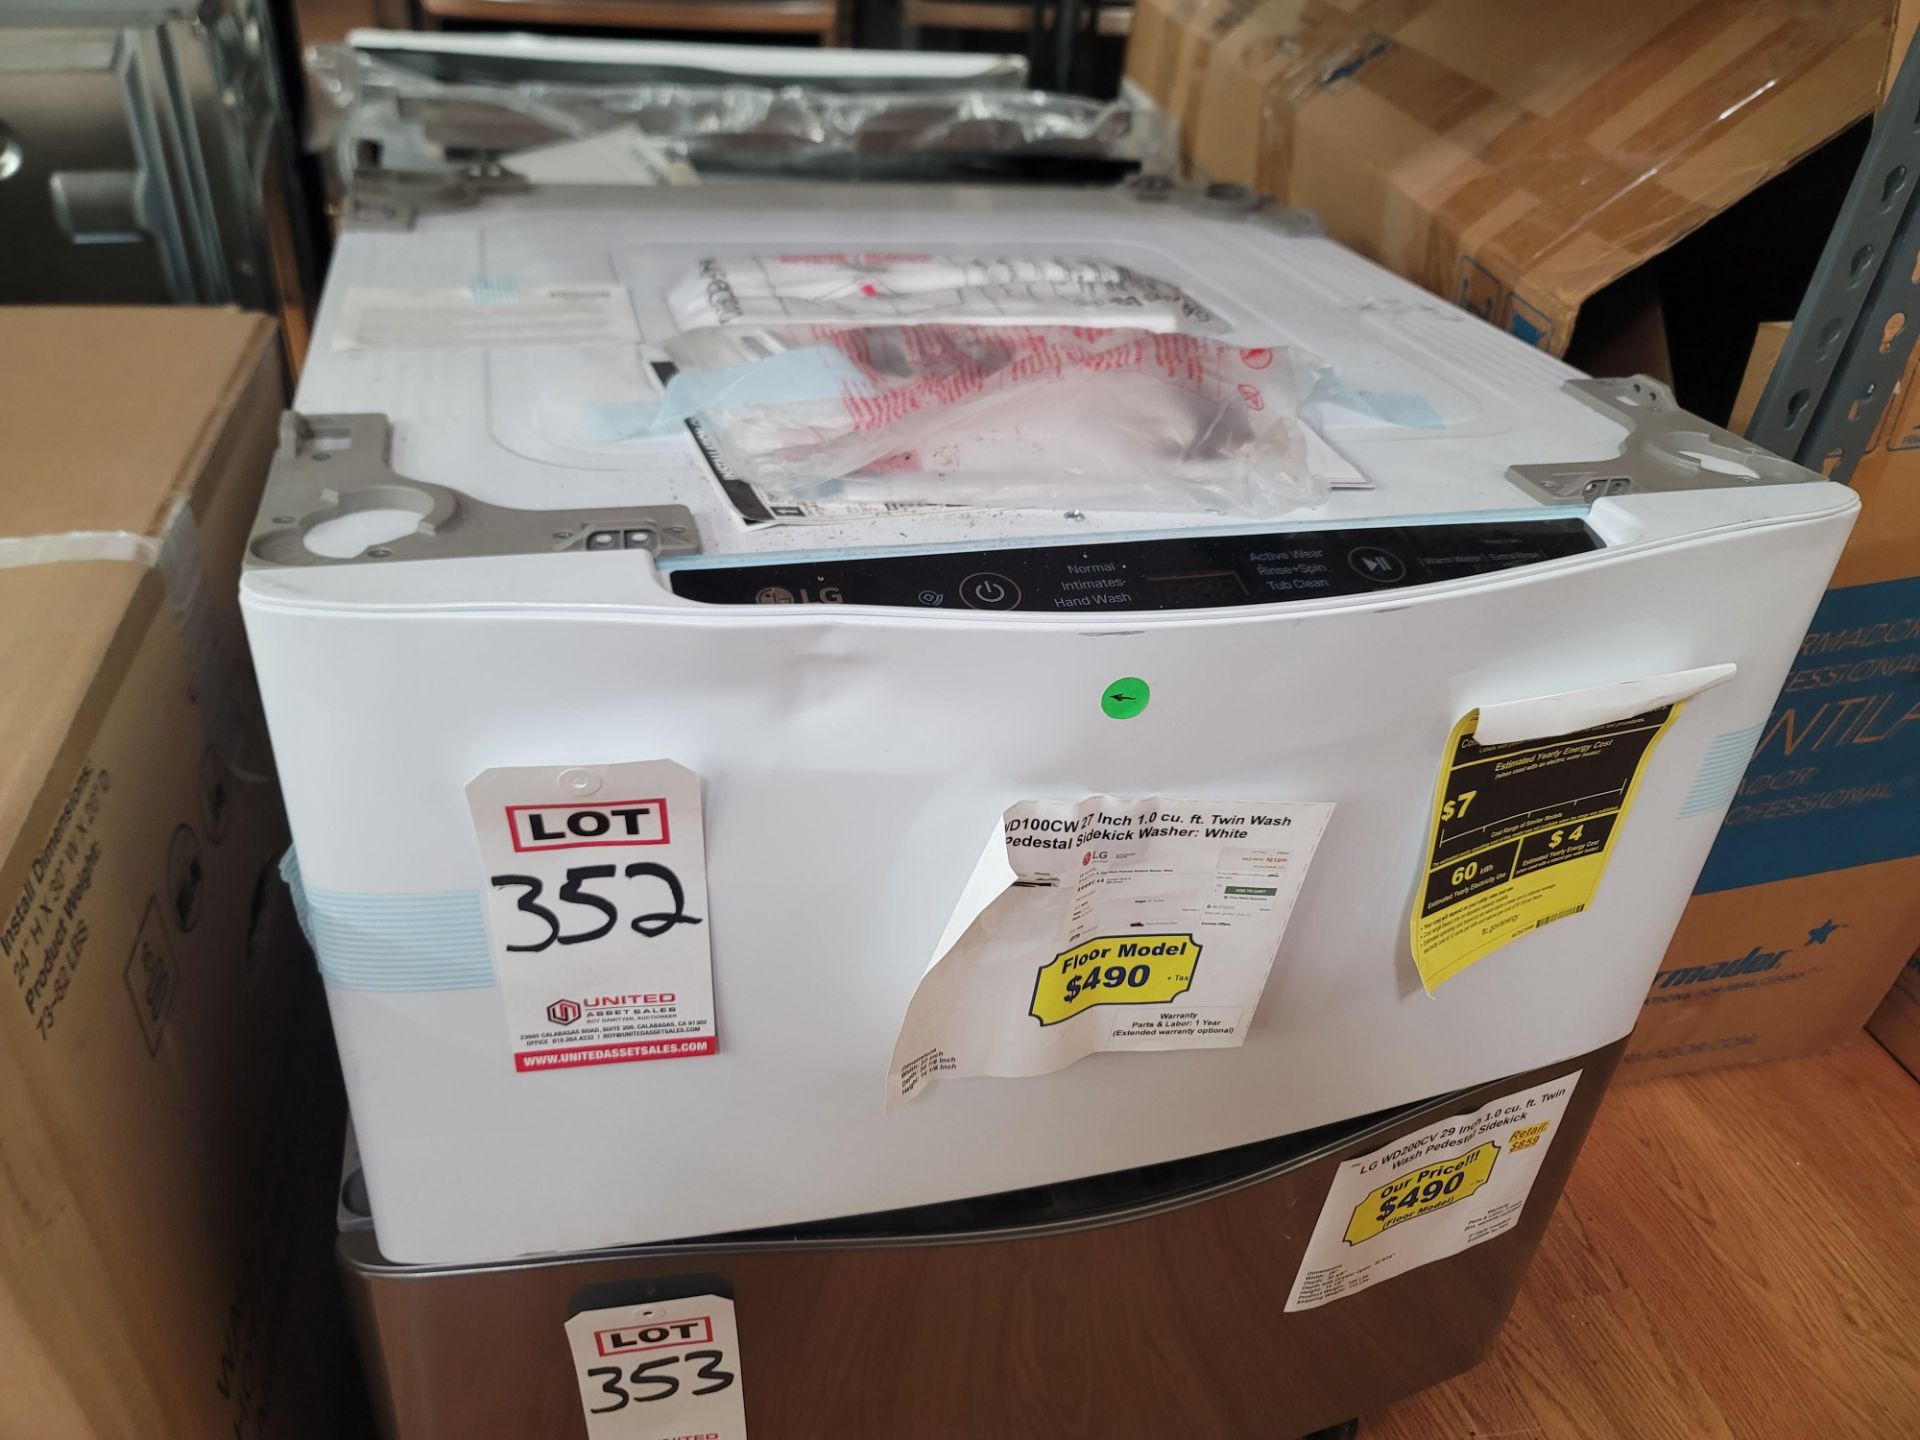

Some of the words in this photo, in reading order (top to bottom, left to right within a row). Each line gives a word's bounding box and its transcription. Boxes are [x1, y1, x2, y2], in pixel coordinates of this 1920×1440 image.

[1250, 552, 1290, 562] Active
[1289, 549, 1324, 560] Wear
[1066, 561, 1117, 575] Normal
[799, 586, 845, 604] LG
[1060, 578, 1123, 592] Intimates
[1264, 580, 1293, 591] Tub
[1292, 578, 1330, 590] Clean
[1054, 596, 1091, 609] Hand
[1091, 592, 1132, 606] Wash
[1494, 754, 1537, 772] Estimated
[1536, 749, 1563, 761] Yearly
[1562, 743, 1593, 756] Energy
[1592, 738, 1614, 750] Cost
[1440, 789, 1478, 822] $7
[528, 807, 651, 841] LOT
[1080, 812, 1095, 830] 27
[1097, 811, 1133, 827] Inch
[1137, 811, 1158, 826] 1.0
[1160, 812, 1185, 824] cu.
[1189, 813, 1205, 826] ft.
[1210, 814, 1247, 827] Twin
[1249, 815, 1292, 827] Wash
[1567, 823, 1585, 841] 4
[1005, 834, 1073, 850] Pedestal
[1076, 827, 1134, 848] Sidekick
[1137, 825, 1200, 840] Washer:
[1203, 827, 1248, 840] White
[1586, 839, 1600, 848] Cost
[1092, 850, 1109, 860] LG
[1451, 861, 1478, 886] 60
[490, 861, 704, 953] 352
[1427, 892, 1454, 910] Estimated
[0, 877, 37, 958] Install
[25, 917, 69, 1016] Product
[1060, 946, 1112, 975] Floor
[1117, 941, 1188, 959] Model
[1063, 963, 1151, 1004] $490
[583, 992, 677, 1008] UNITED
[586, 1009, 631, 1018] ASSET
[633, 1006, 677, 1015] SALES
[1132, 1020, 1154, 1028] Parts
[1156, 1020, 1163, 1028] &
[1165, 1019, 1193, 1028] Labor:
[1203, 1019, 1222, 1027] Year
[1160, 1011, 1198, 1020] Warranty
[540, 1029, 581, 1038] CALABASAS
[1112, 1028, 1156, 1037] (Extended
[1158, 1027, 1195, 1036] warranty
[1197, 1026, 1234, 1035] optional)
[522, 1040, 708, 1068] WWW.UNITEDASSETSALES.COM
[1359, 1160, 1379, 1175] LG
[1381, 1132, 1440, 1166] WD200CV
[1439, 1126, 1456, 1139] 29
[1459, 1117, 1482, 1134] Inch
[1483, 1108, 1503, 1122] 1.0
[1503, 1105, 1522, 1115] cu.
[1525, 1098, 1537, 1108] ft.
[1540, 1087, 1567, 1103] Twin
[1392, 1149, 1423, 1170] Wash
[1425, 1128, 1478, 1154] Pedestal
[1477, 1110, 1529, 1136] Sidekick
[1508, 1134, 1541, 1155] $859
[1380, 1177, 1413, 1199] Our
[1416, 1149, 1481, 1183] Price!!!
[1375, 1171, 1465, 1222] $490
[1382, 1211, 1417, 1231] (Floor
[1417, 1195, 1455, 1215] Model)
[610, 1322, 699, 1349] LOT
[587, 1350, 735, 1414] 353
